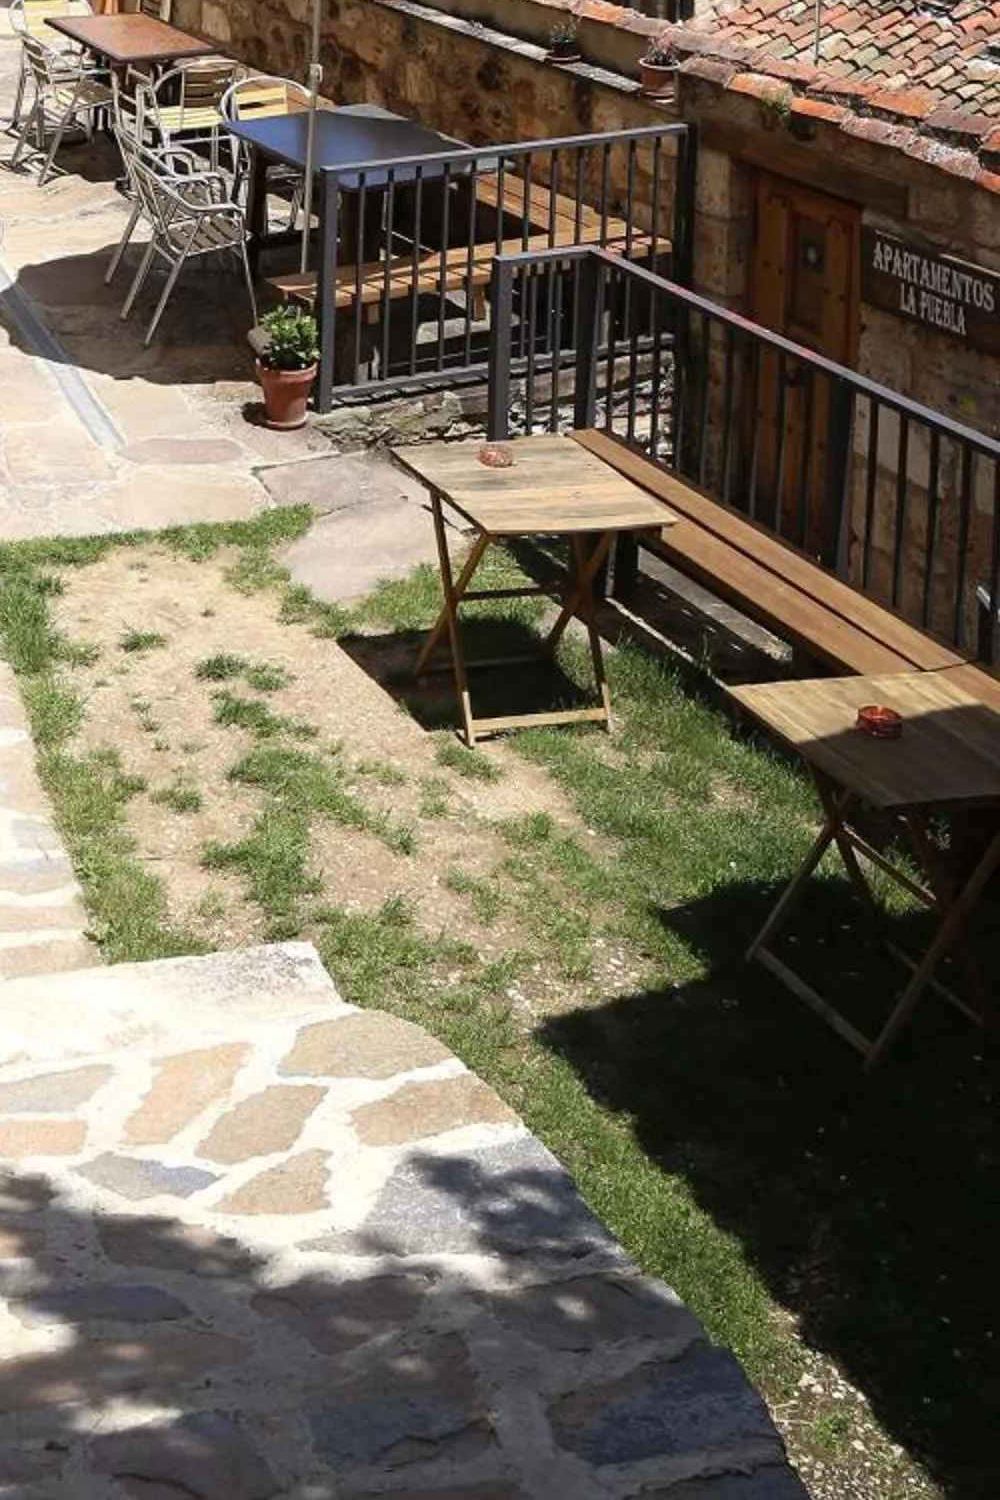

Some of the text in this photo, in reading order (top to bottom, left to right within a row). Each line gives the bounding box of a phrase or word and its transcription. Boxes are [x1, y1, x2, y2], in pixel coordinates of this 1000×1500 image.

[872, 241, 995, 313] APARTAMENTOS
[899, 282, 967, 335] LA PUEBLA
